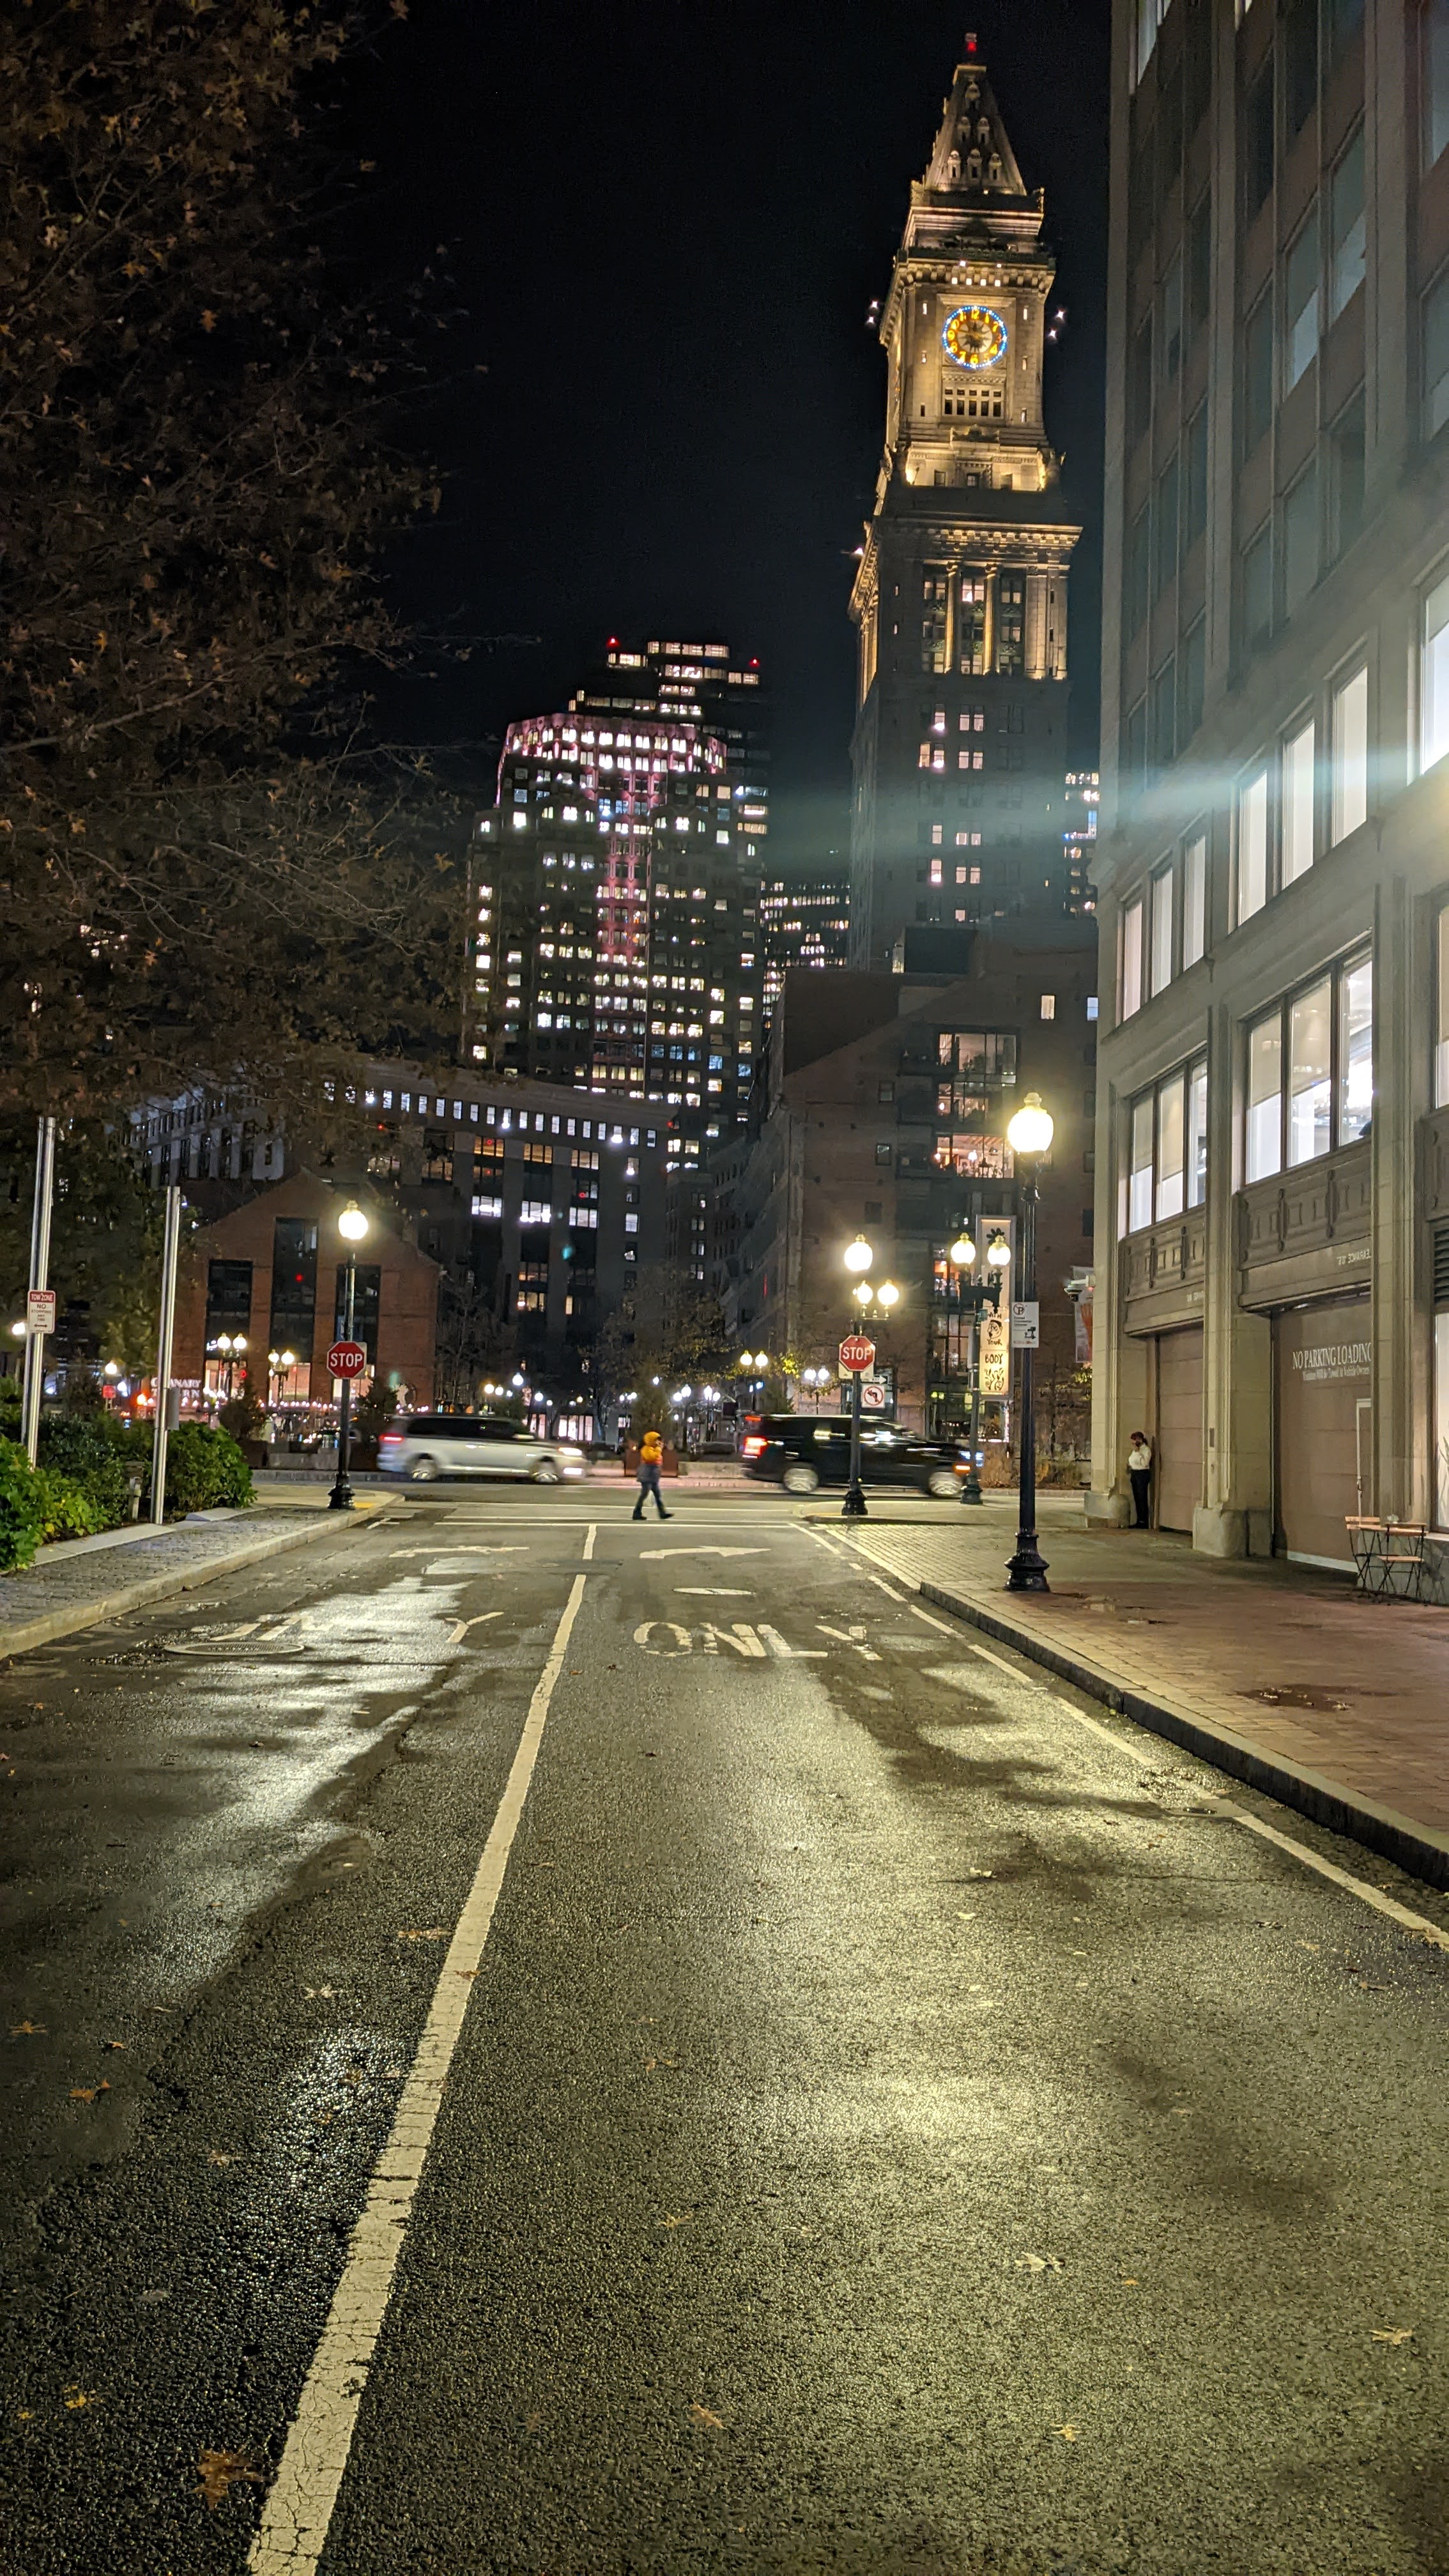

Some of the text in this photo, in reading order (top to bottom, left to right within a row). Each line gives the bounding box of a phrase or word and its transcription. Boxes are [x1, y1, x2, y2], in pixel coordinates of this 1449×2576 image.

[970, 309, 980, 320] 12
[947, 330, 955, 341] 9
[995, 334, 1002, 343] 3
[950, 342, 958, 353] 8
[990, 344, 998, 355] 4
[960, 351, 966, 362] 7
[970, 355, 979, 365] 6
[41, 1293, 53, 1301] ZONE
[842, 1347, 871, 1361] STOP
[985, 1354, 1003, 1364] BODY
[1292, 1351, 1303, 1370] NO
[1304, 1347, 1336, 1368] PARKING
[330, 1353, 363, 1367] STOP
[151, 1377, 202, 1388] GANARY
[633, 1621, 883, 1661] ONLY
